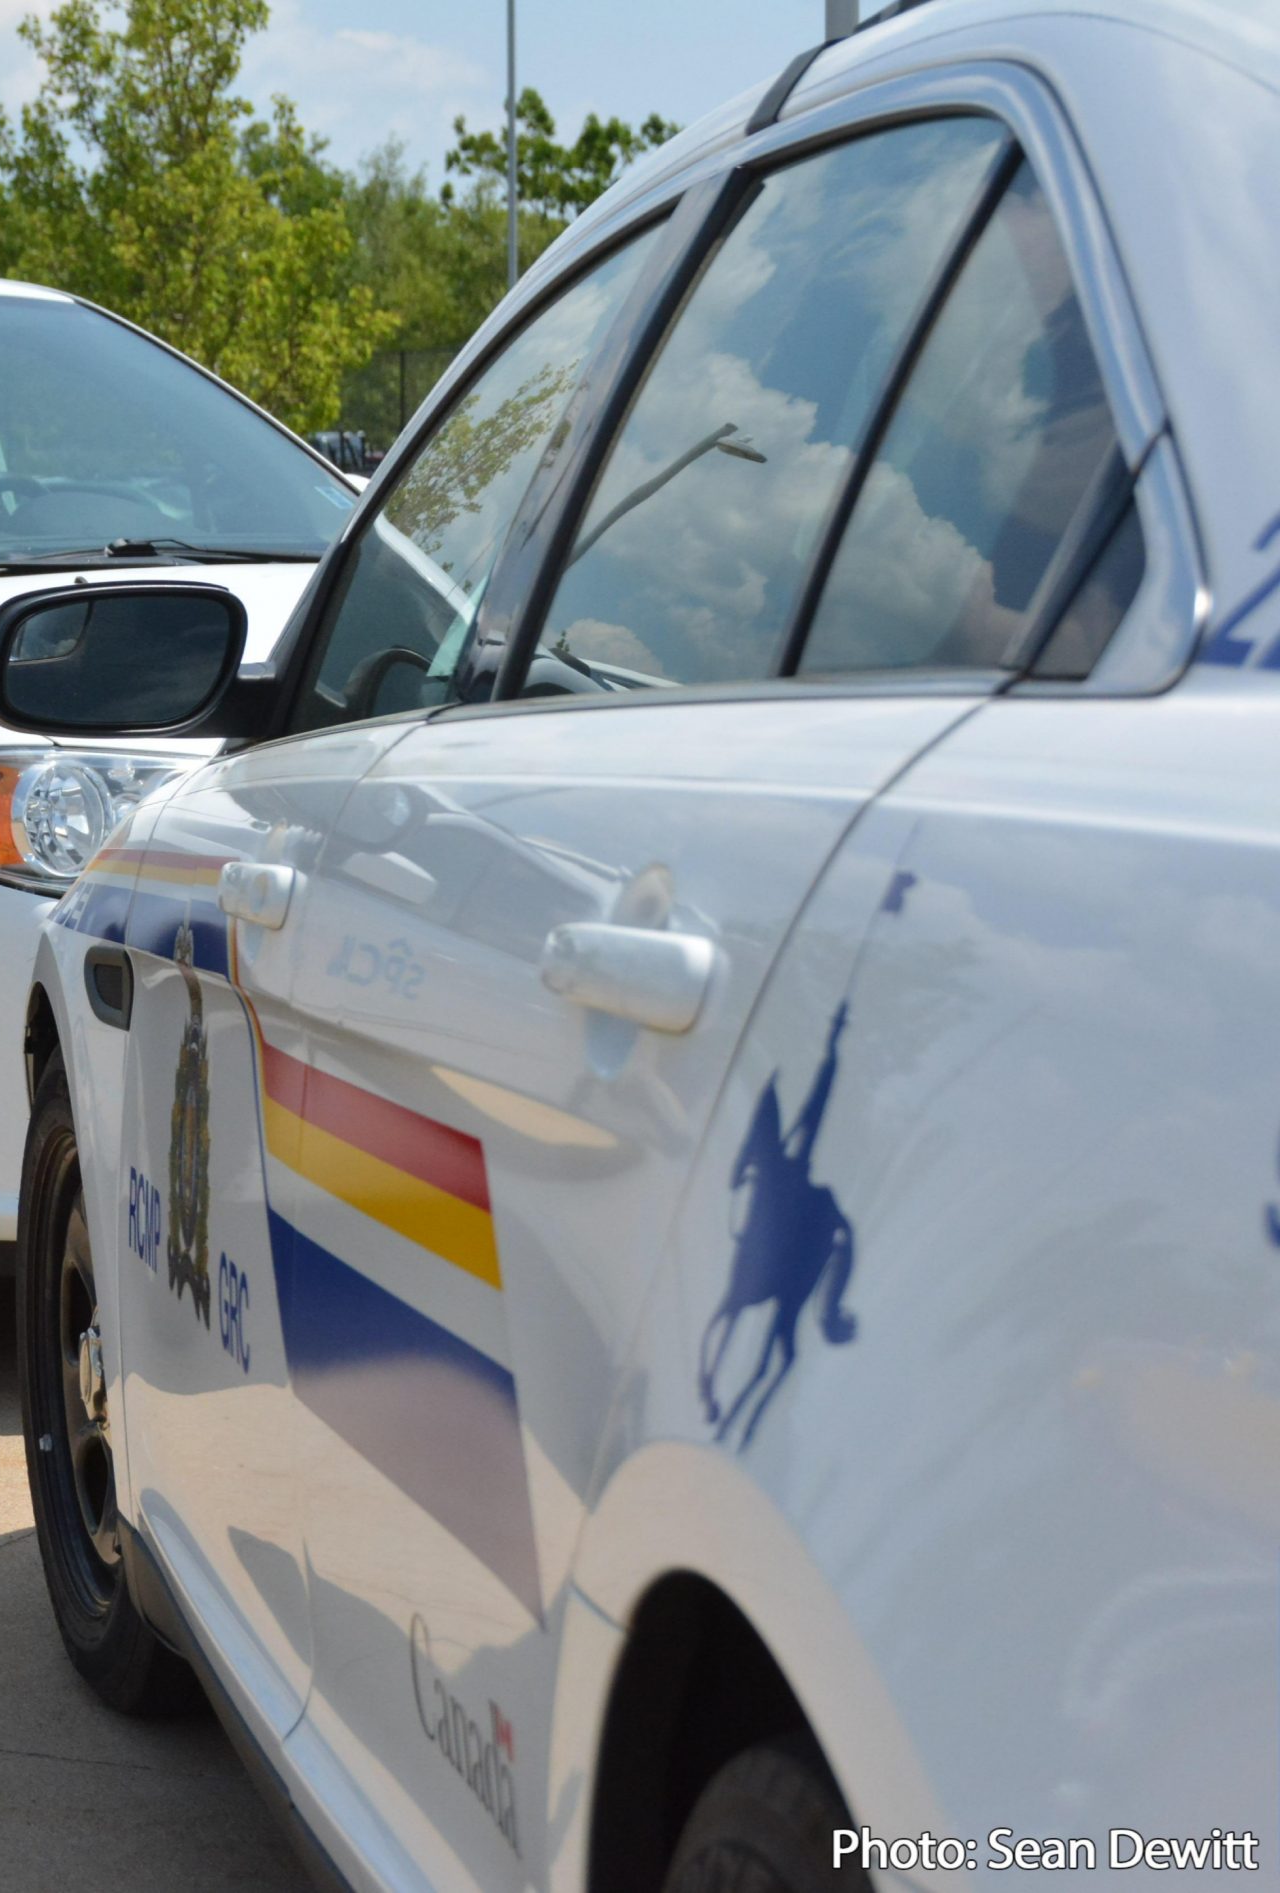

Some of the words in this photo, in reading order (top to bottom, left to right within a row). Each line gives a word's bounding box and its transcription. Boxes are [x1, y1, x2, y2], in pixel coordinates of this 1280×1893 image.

[128, 1165, 161, 1275] RCMP
[219, 1251, 250, 1375] GRC
[409, 1611, 523, 1861] Canada
